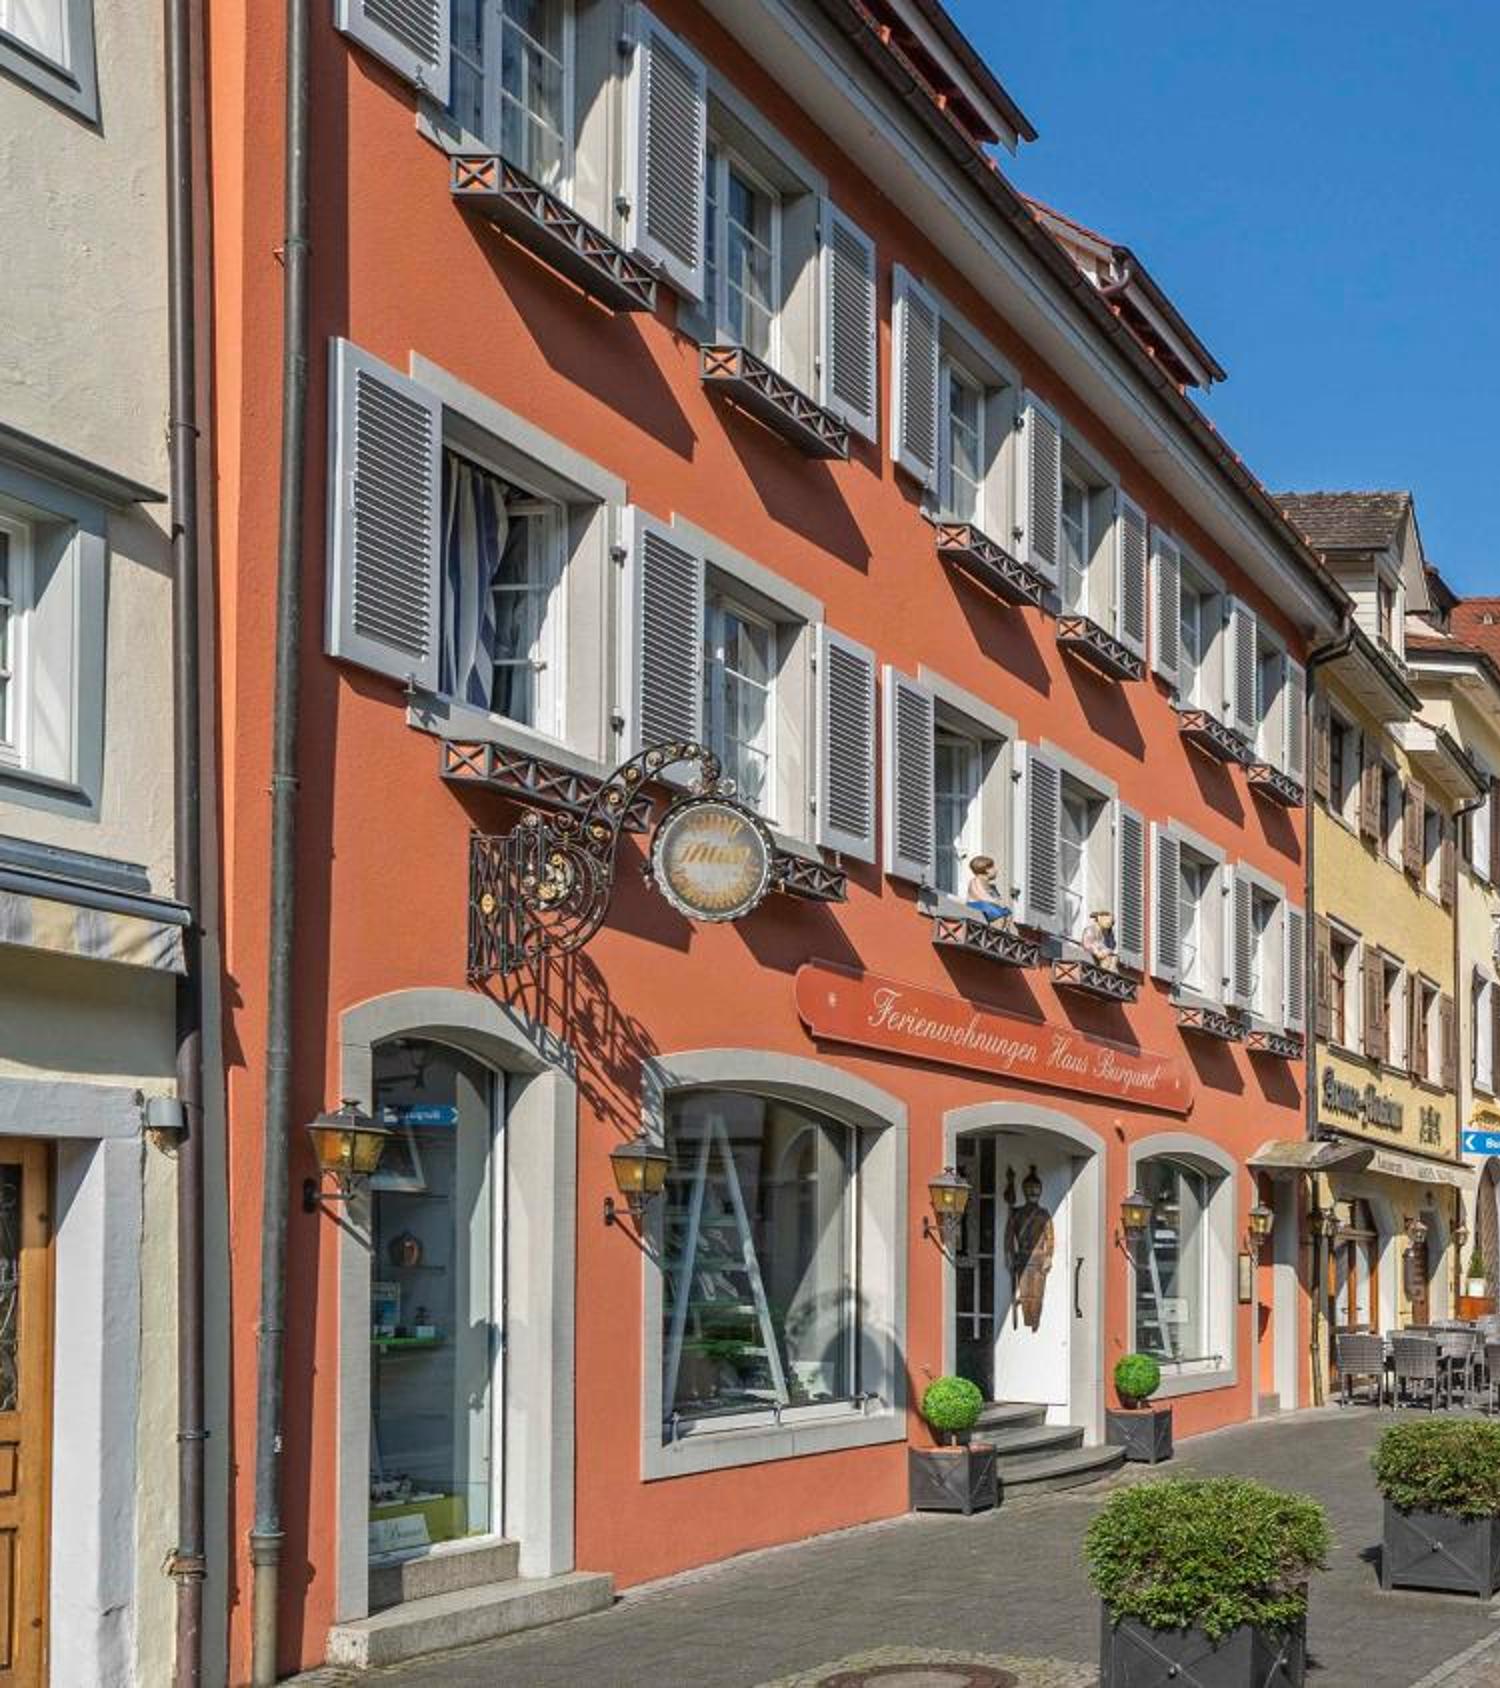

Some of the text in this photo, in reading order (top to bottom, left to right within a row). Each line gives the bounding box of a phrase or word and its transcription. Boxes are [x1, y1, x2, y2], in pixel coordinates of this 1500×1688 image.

[867, 986, 1161, 1094] Ferienwohnungen Haus Burgund
